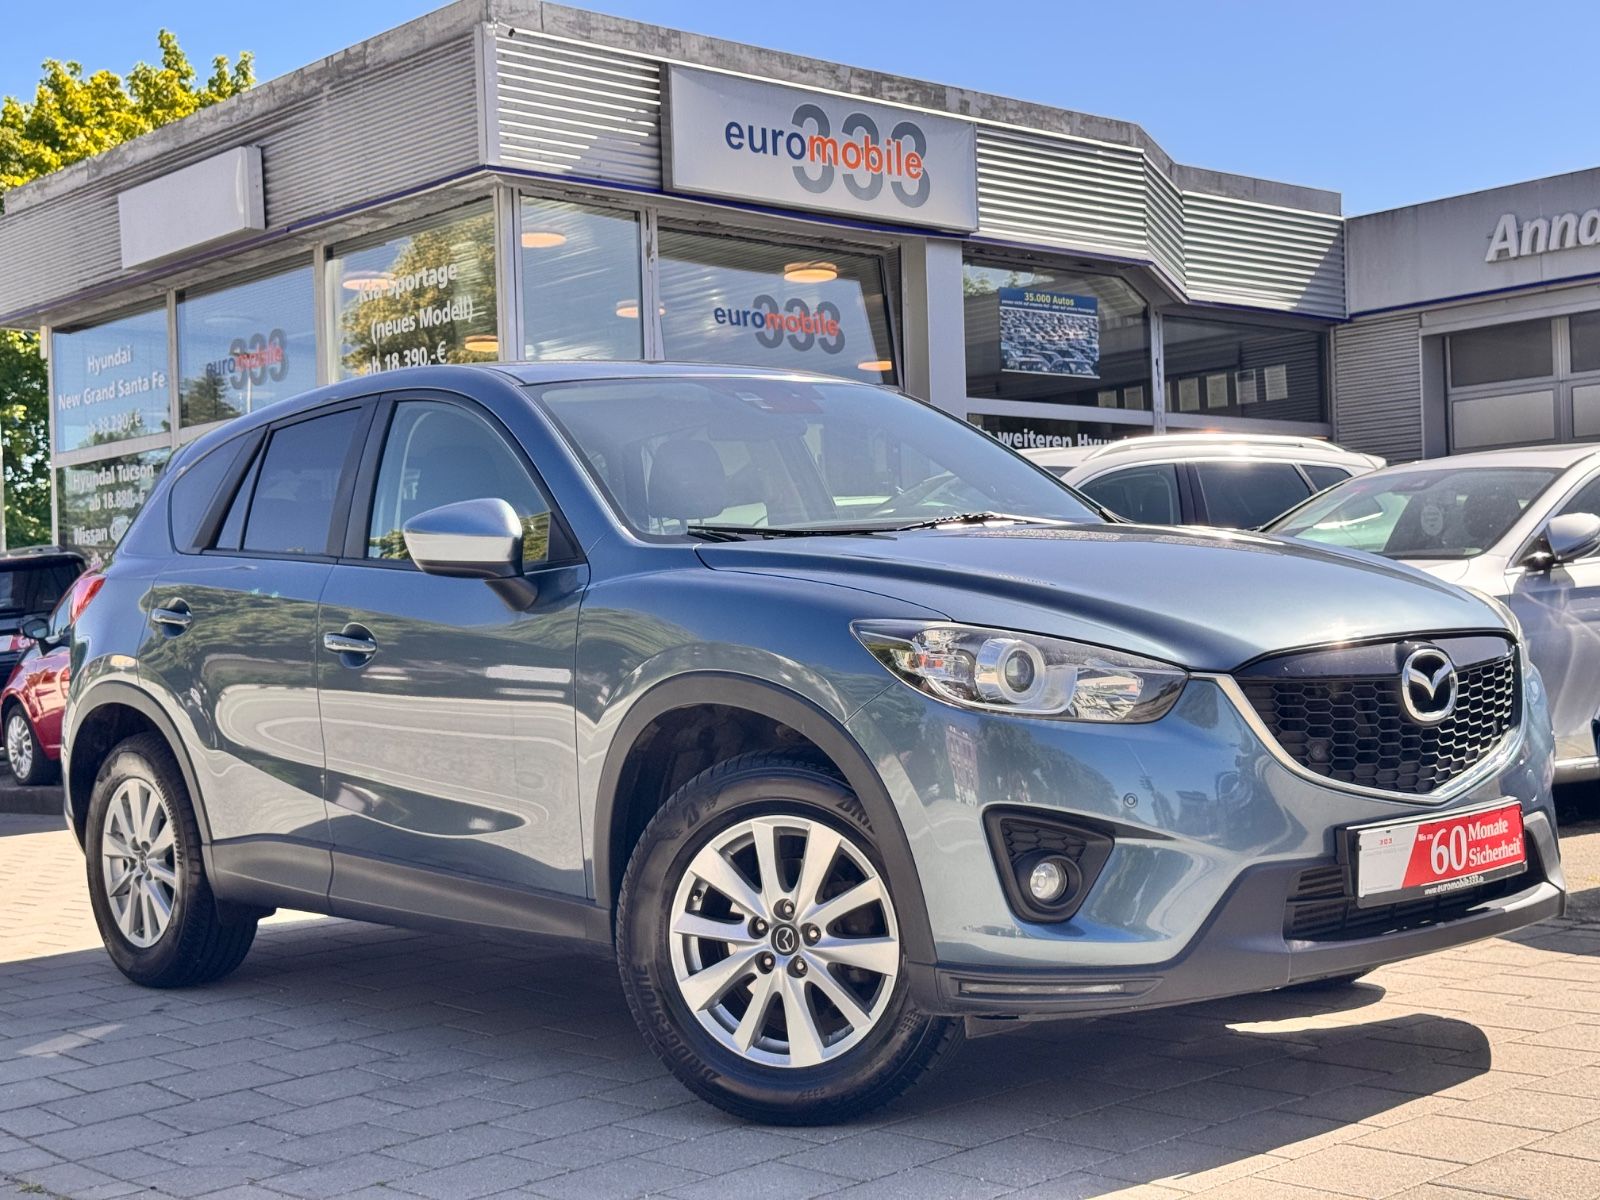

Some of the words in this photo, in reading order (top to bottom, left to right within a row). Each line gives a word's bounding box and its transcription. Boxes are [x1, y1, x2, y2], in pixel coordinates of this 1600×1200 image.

[725, 120, 923, 180] euromobile
[1024, 292, 1051, 304] 35.000
[1052, 295, 1074, 306] Autos
[370, 314, 416, 344] (neues
[419, 295, 473, 329] Modell)
[714, 307, 839, 336] euromobile
[87, 345, 132, 376] Hyundai
[58, 394, 81, 411] New
[83, 380, 116, 405] Grand
[117, 375, 150, 398] Santa
[151, 370, 166, 390] Fe
[998, 428, 1072, 448] weiteren
[117, 464, 155, 482] Tucson
[89, 494, 101, 511] ab
[73, 526, 108, 545] Nissan
[1430, 825, 1468, 875] 60
[1468, 818, 1509, 842] Monate
